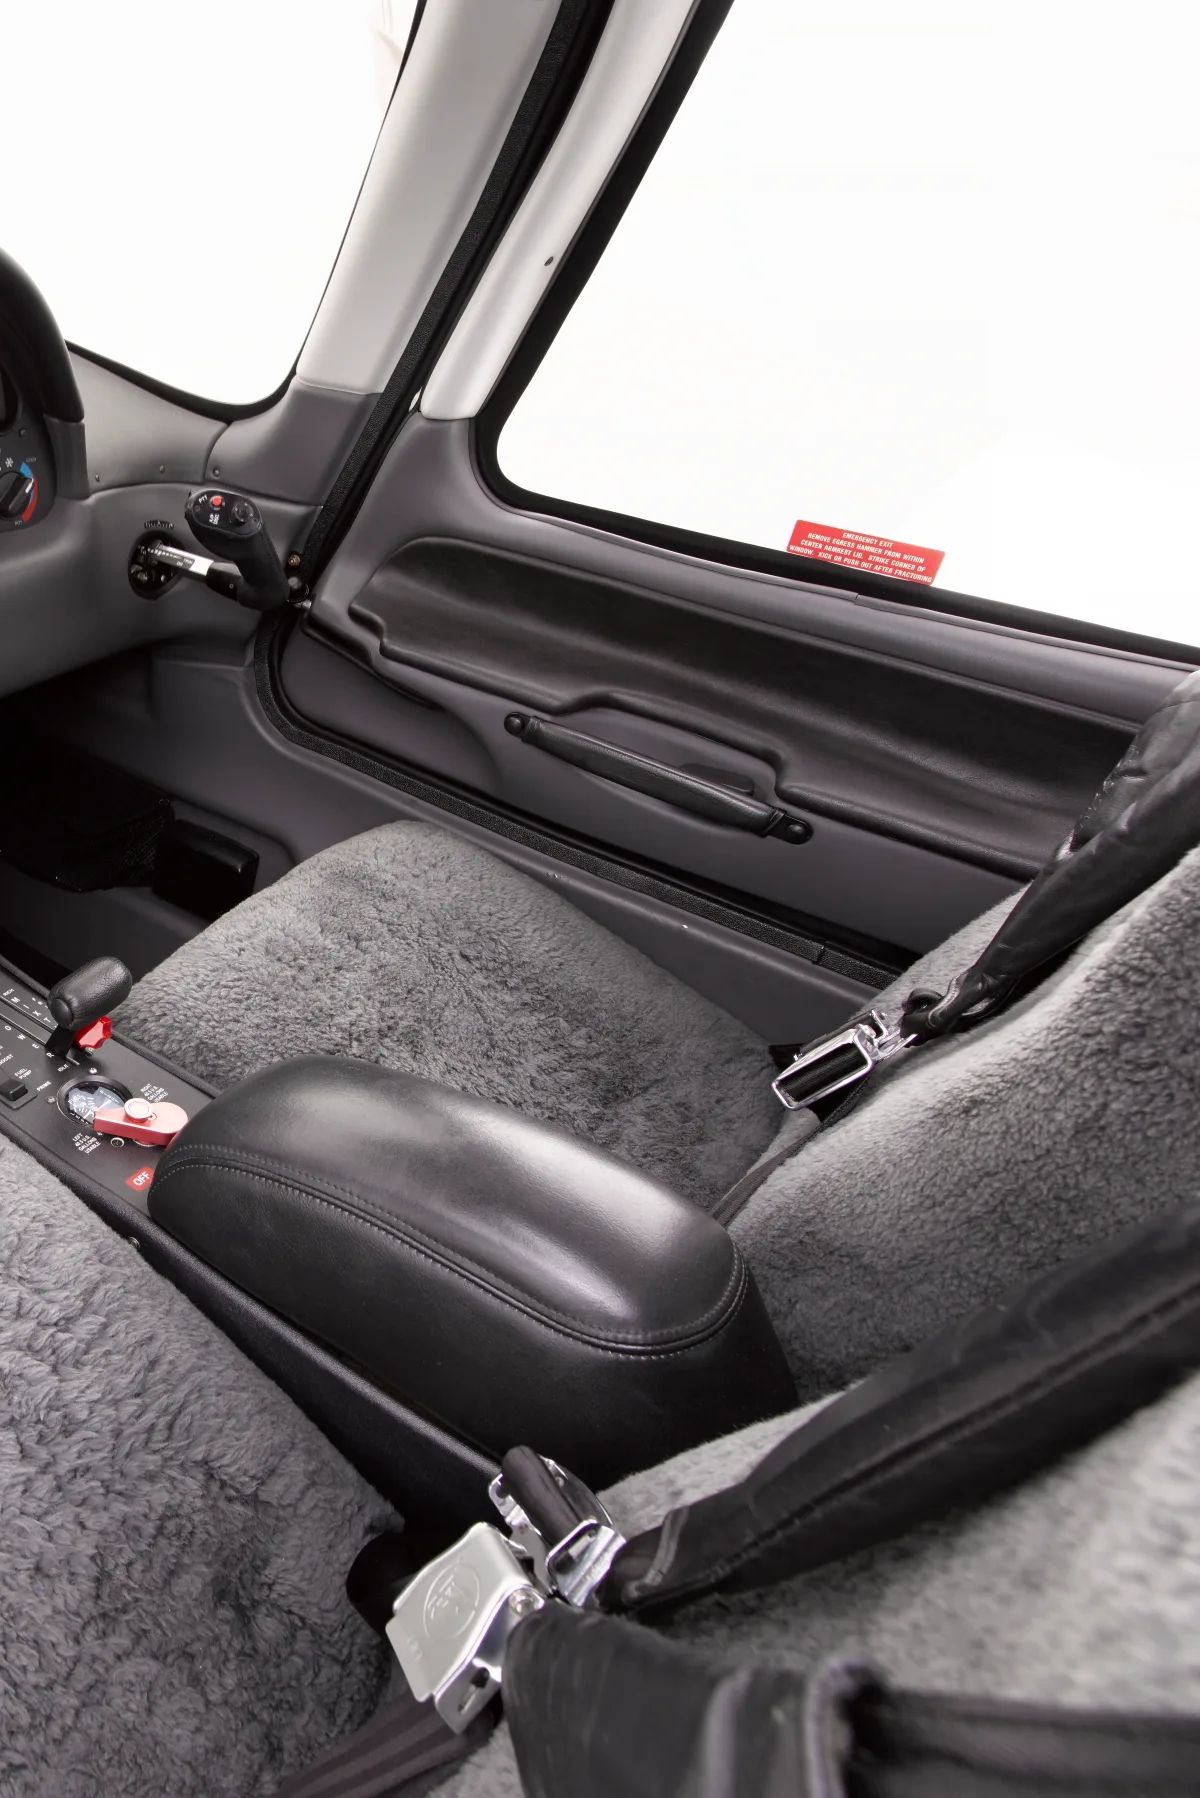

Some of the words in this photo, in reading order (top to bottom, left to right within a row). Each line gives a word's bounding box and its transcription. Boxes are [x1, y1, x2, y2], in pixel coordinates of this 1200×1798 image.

[198, 495, 208, 504] PTT
[842, 532, 879, 547] EMERGENCY
[878, 540, 894, 549] EXIT
[807, 532, 831, 543] REMOVE
[832, 537, 855, 549] EGRESS
[856, 541, 883, 555] HAMMER
[883, 548, 902, 559] FROM
[902, 552, 925, 564] WITHIN
[800, 539, 823, 550] CENTER
[823, 544, 851, 558] ARMREST
[852, 551, 864, 560] LID.
[867, 554, 890, 565] STRIKE
[890, 559, 916, 571] CORNER
[917, 564, 926, 572] OF
[789, 544, 815, 556] WINDOW.
[818, 551, 832, 561] KICK
[833, 555, 842, 563] OR
[843, 557, 860, 567] PUSH
[860, 561, 873, 569] OUT
[873, 563, 893, 574] AFTER
[894, 568, 933, 584] FRACTURING
[2, 988, 15, 997] RICH
[14, 1068, 28, 1077] FUEL
[57, 1064, 69, 1072] IDLE
[19, 1070, 32, 1080] PUMP
[36, 1080, 52, 1092] PRIME
[140, 1083, 152, 1093] RIGHT
[147, 1087, 165, 1100] GALLONS
[72, 1133, 82, 1142] LEFT
[78, 1137, 98, 1151] GALLONS
[84, 1142, 101, 1154] USABLE
[133, 1171, 150, 1186] OFF
